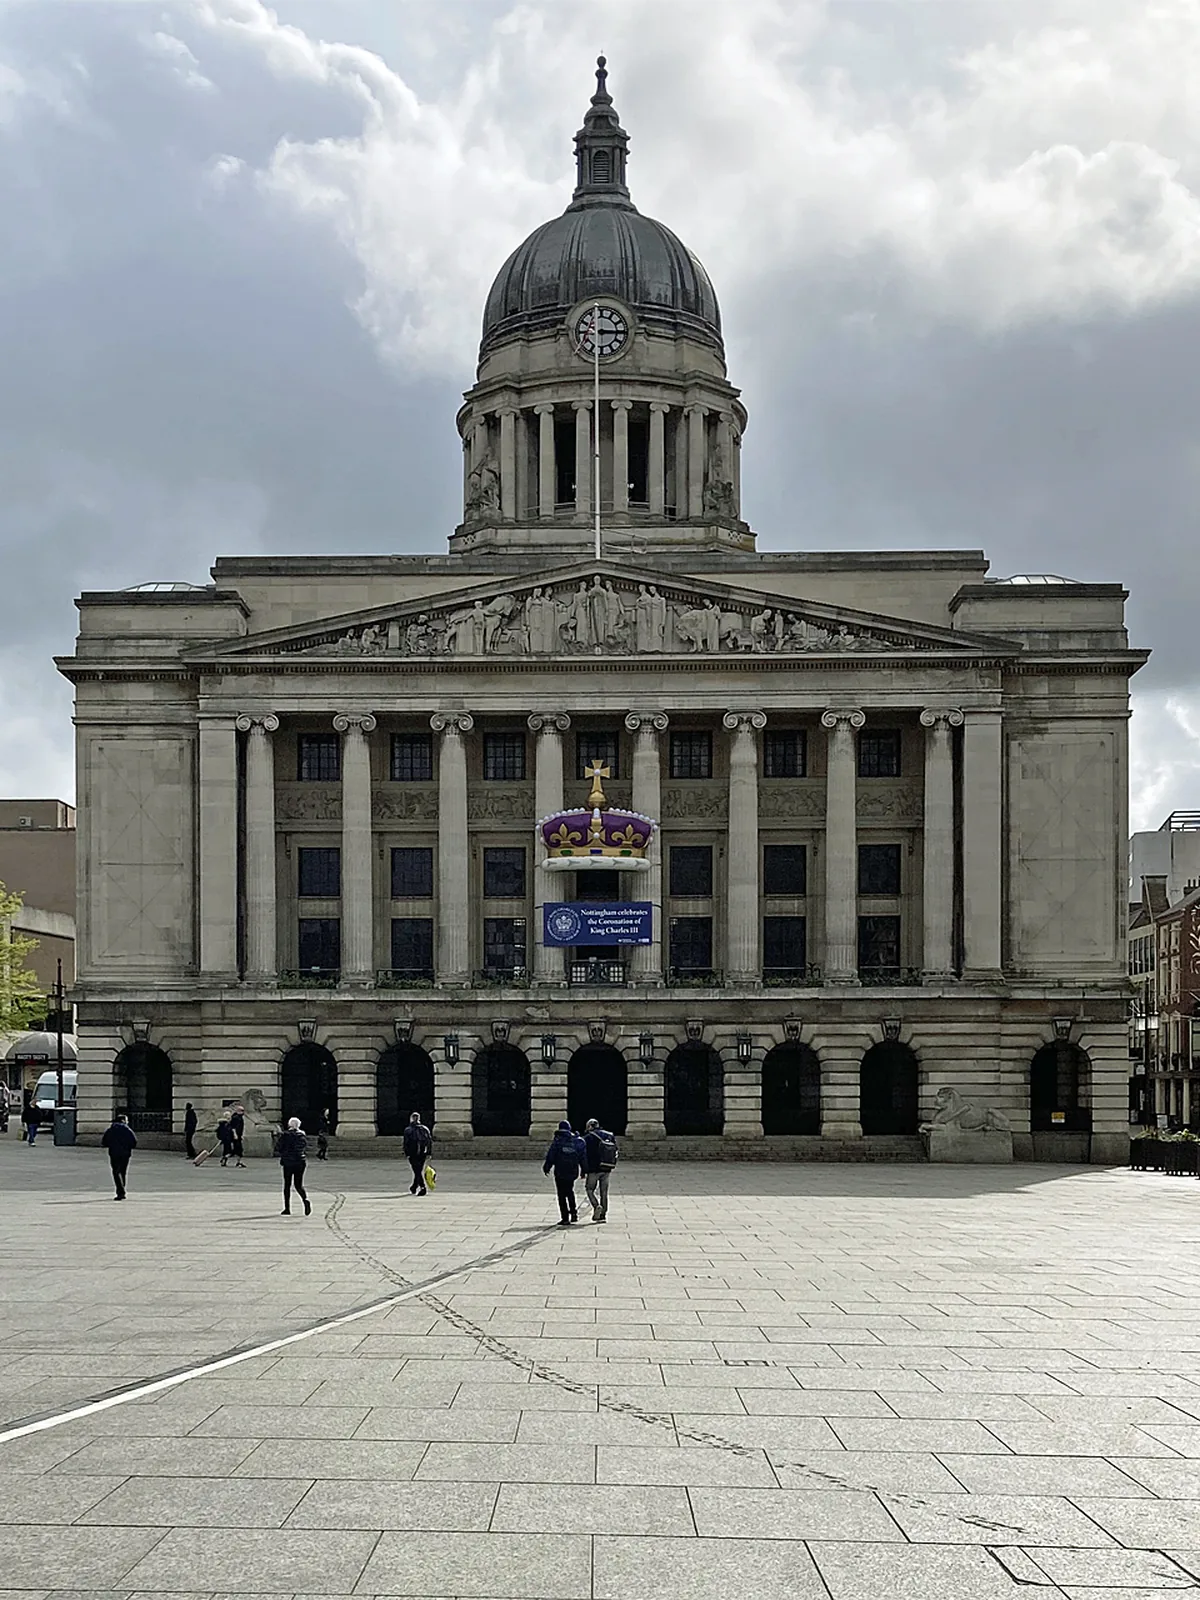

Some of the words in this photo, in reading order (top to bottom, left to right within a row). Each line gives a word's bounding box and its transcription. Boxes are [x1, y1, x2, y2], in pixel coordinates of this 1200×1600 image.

[580, 909, 617, 917] Nottingham
[634, 917, 642, 925] of
[590, 927, 605, 935] King
